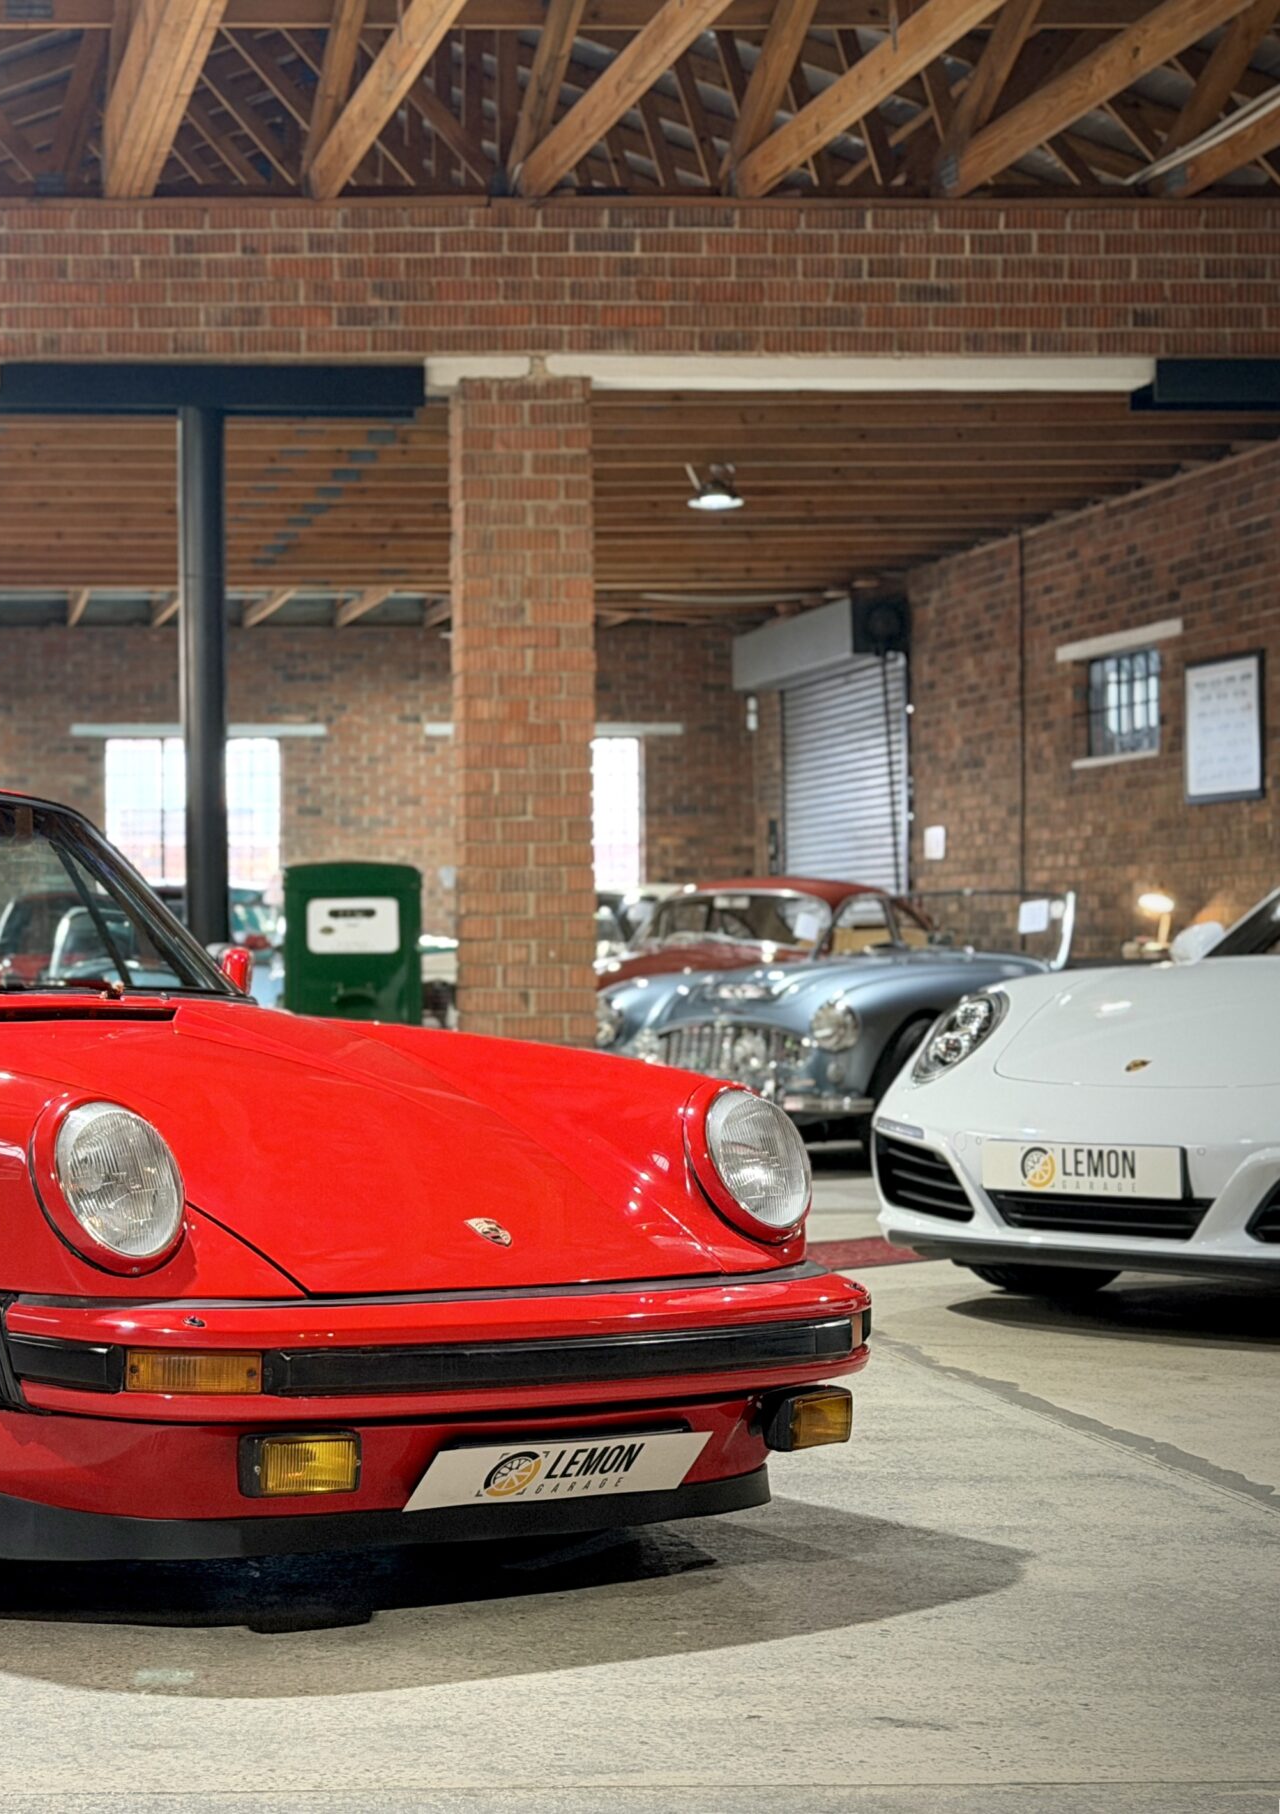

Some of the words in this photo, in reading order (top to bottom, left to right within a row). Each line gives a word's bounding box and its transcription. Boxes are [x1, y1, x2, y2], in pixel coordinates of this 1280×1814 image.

[1062, 1148, 1136, 1179] LEMON
[1062, 1180, 1137, 1193] GARAGE
[544, 1443, 646, 1480] LEMON
[535, 1477, 624, 1494] GARAGE
